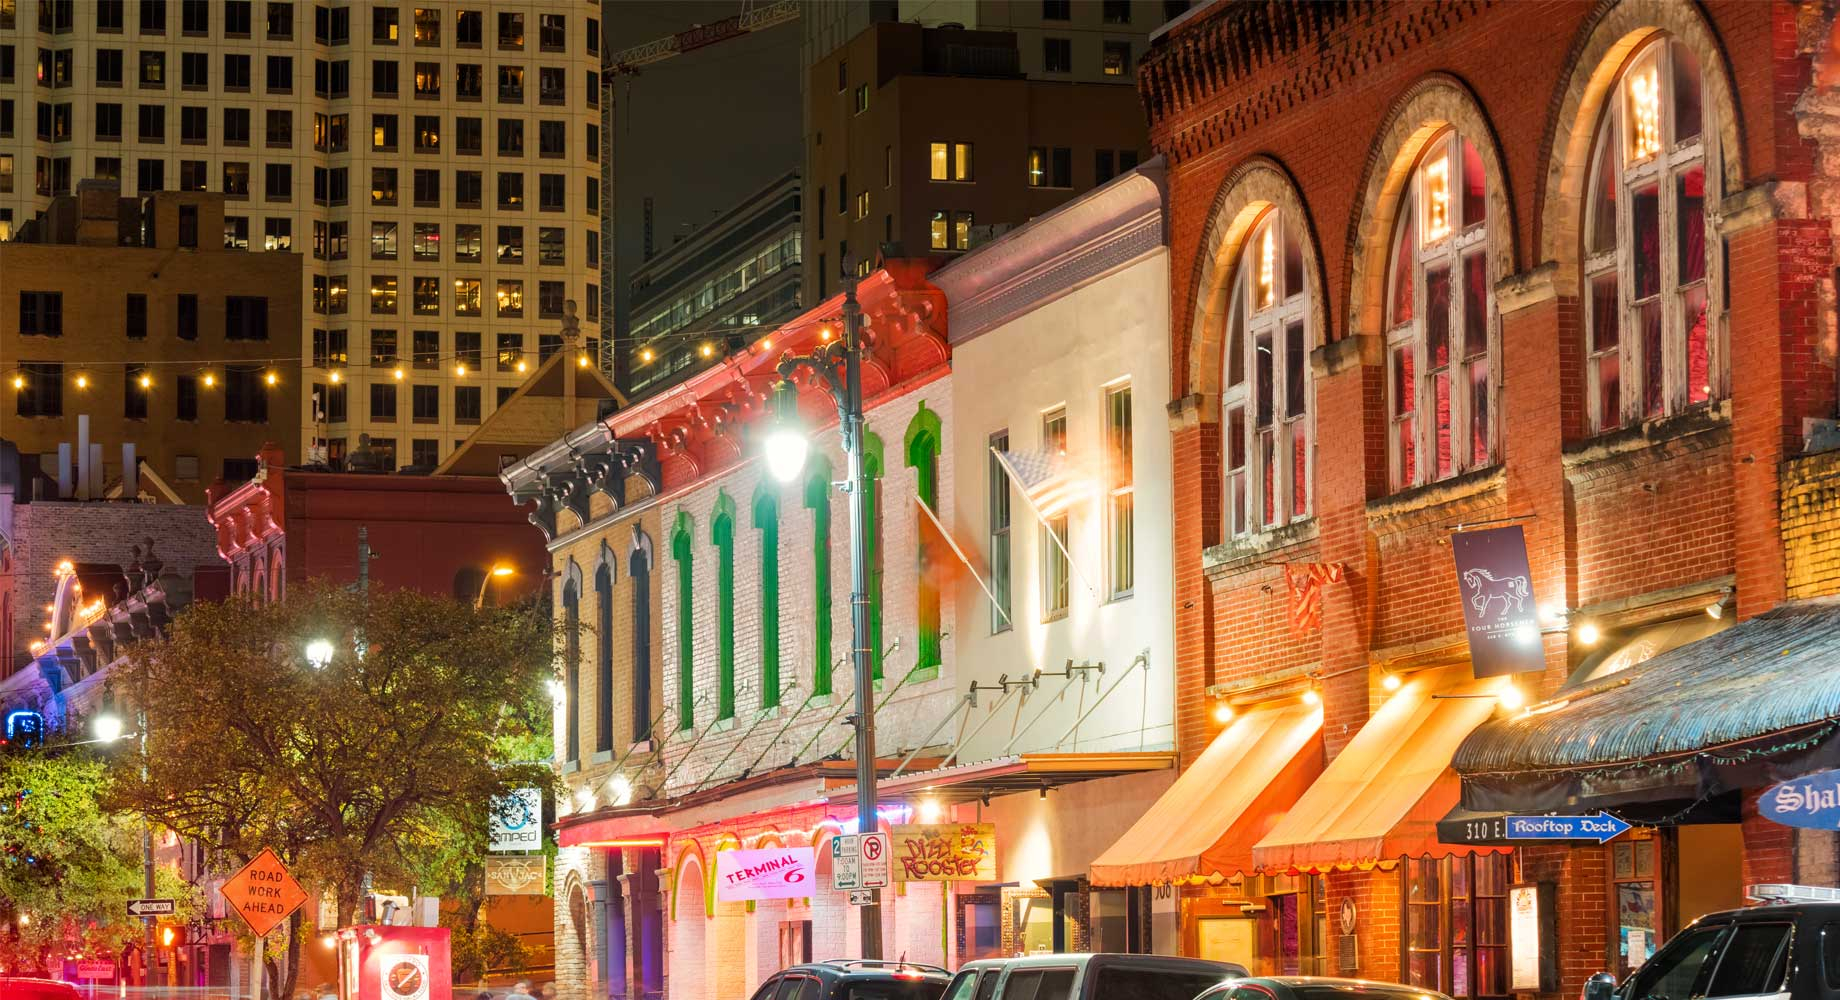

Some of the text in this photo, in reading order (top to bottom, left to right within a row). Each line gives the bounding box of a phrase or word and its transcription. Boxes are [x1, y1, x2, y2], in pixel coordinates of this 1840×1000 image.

[1471, 623, 1492, 632] FOUR
[1466, 821, 1506, 840] 310 E.
[1512, 818, 1617, 835] Rooftop Deck
[833, 839, 840, 854] 2
[250, 870, 283, 882] ROAD
[726, 855, 798, 884] TERMINAL
[783, 867, 806, 883] 6
[248, 886, 281, 898] WORK
[156, 903, 170, 911] WAY
[243, 902, 284, 914] AHEAD
